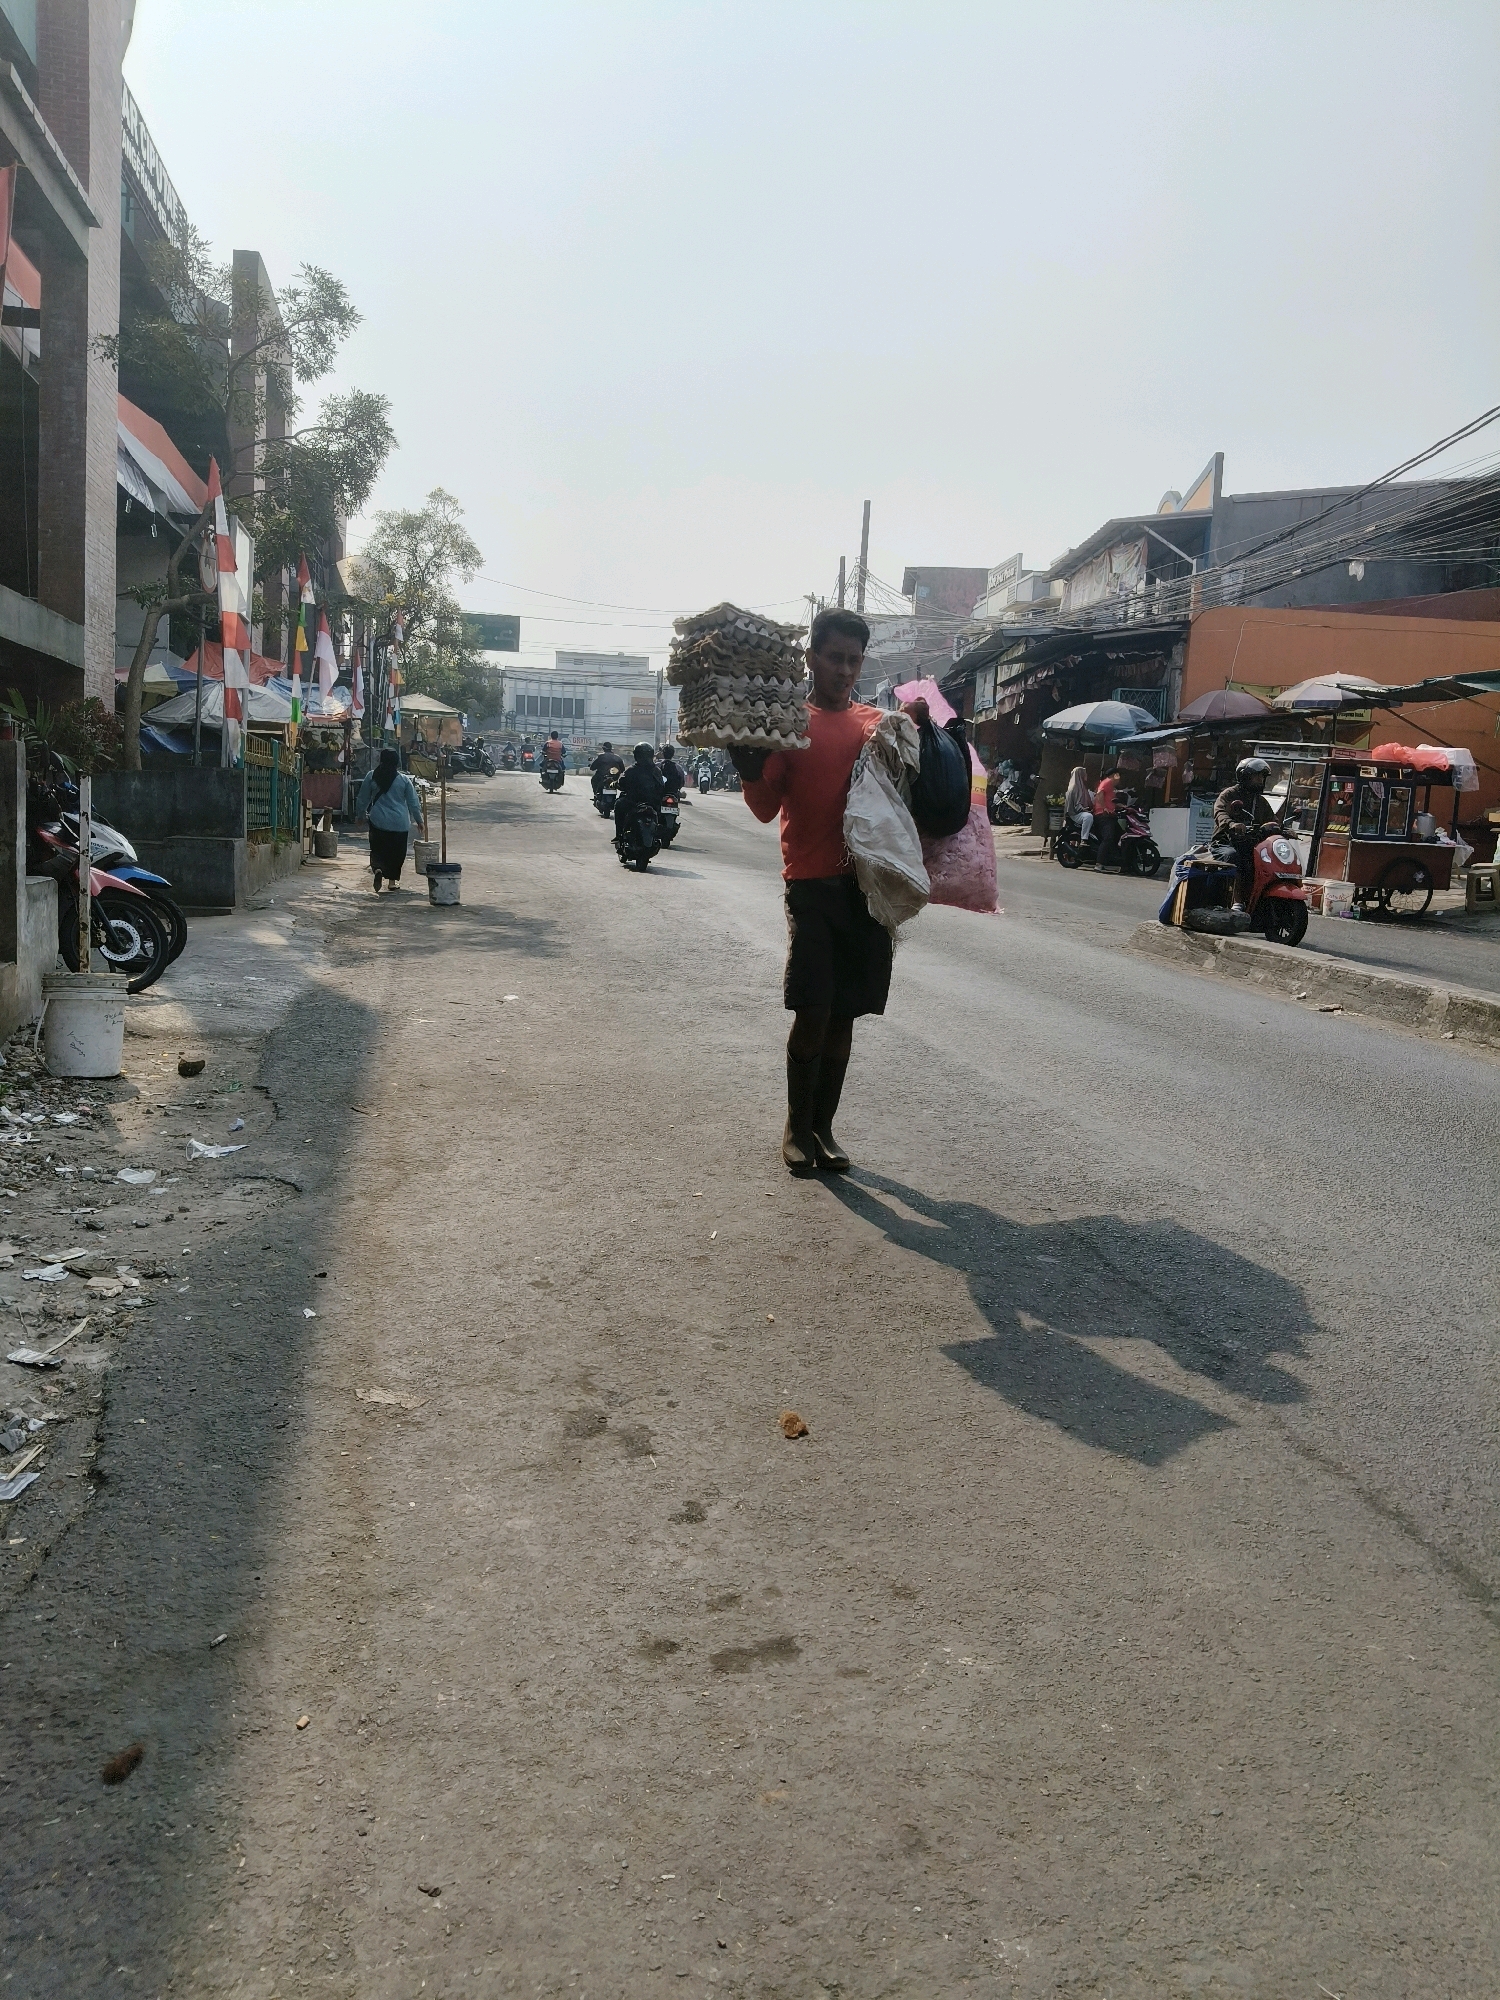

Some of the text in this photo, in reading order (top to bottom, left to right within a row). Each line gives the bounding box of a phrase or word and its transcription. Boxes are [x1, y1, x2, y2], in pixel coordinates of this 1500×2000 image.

[122, 83, 177, 224] AR CIPUTAT
[122, 130, 157, 212] ANGERANG
